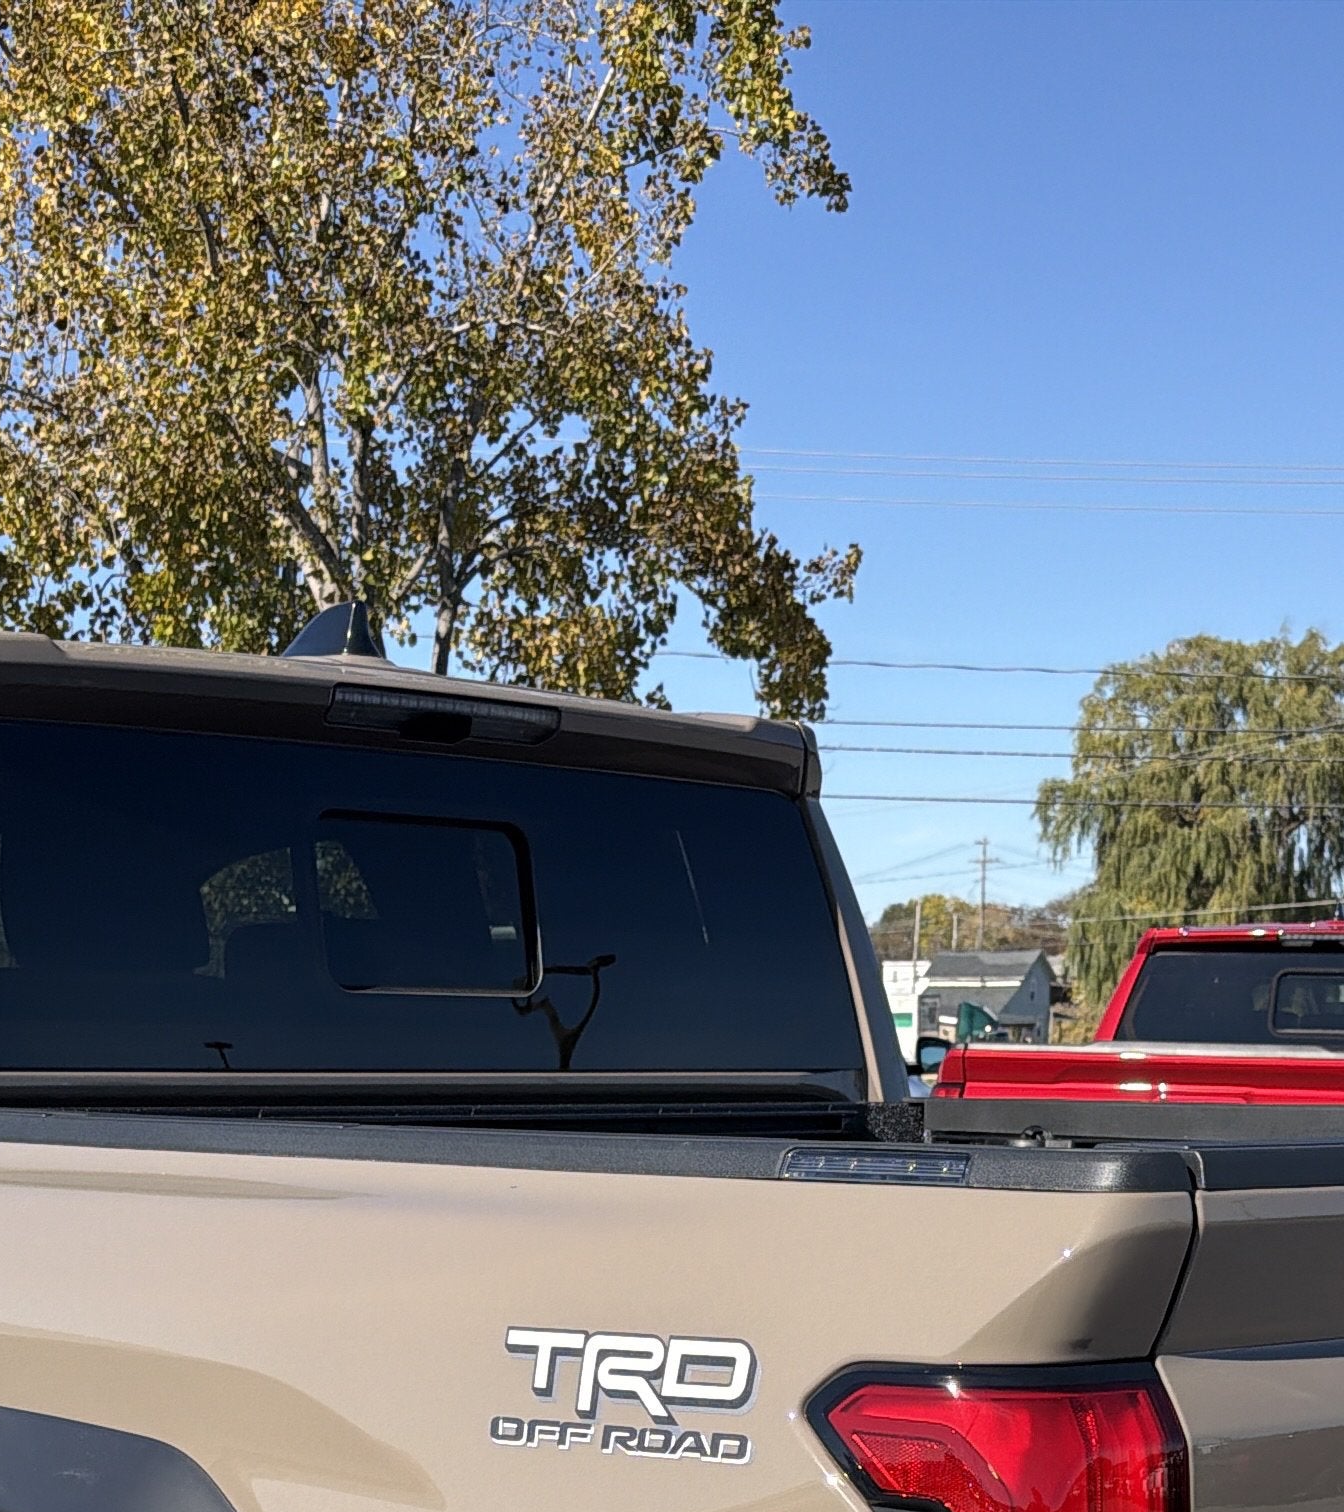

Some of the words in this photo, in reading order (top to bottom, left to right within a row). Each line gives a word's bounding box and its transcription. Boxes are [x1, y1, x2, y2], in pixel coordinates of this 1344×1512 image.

[504, 1326, 761, 1427] TRD
[489, 1415, 595, 1451] OFF
[599, 1423, 754, 1466] ROAD
